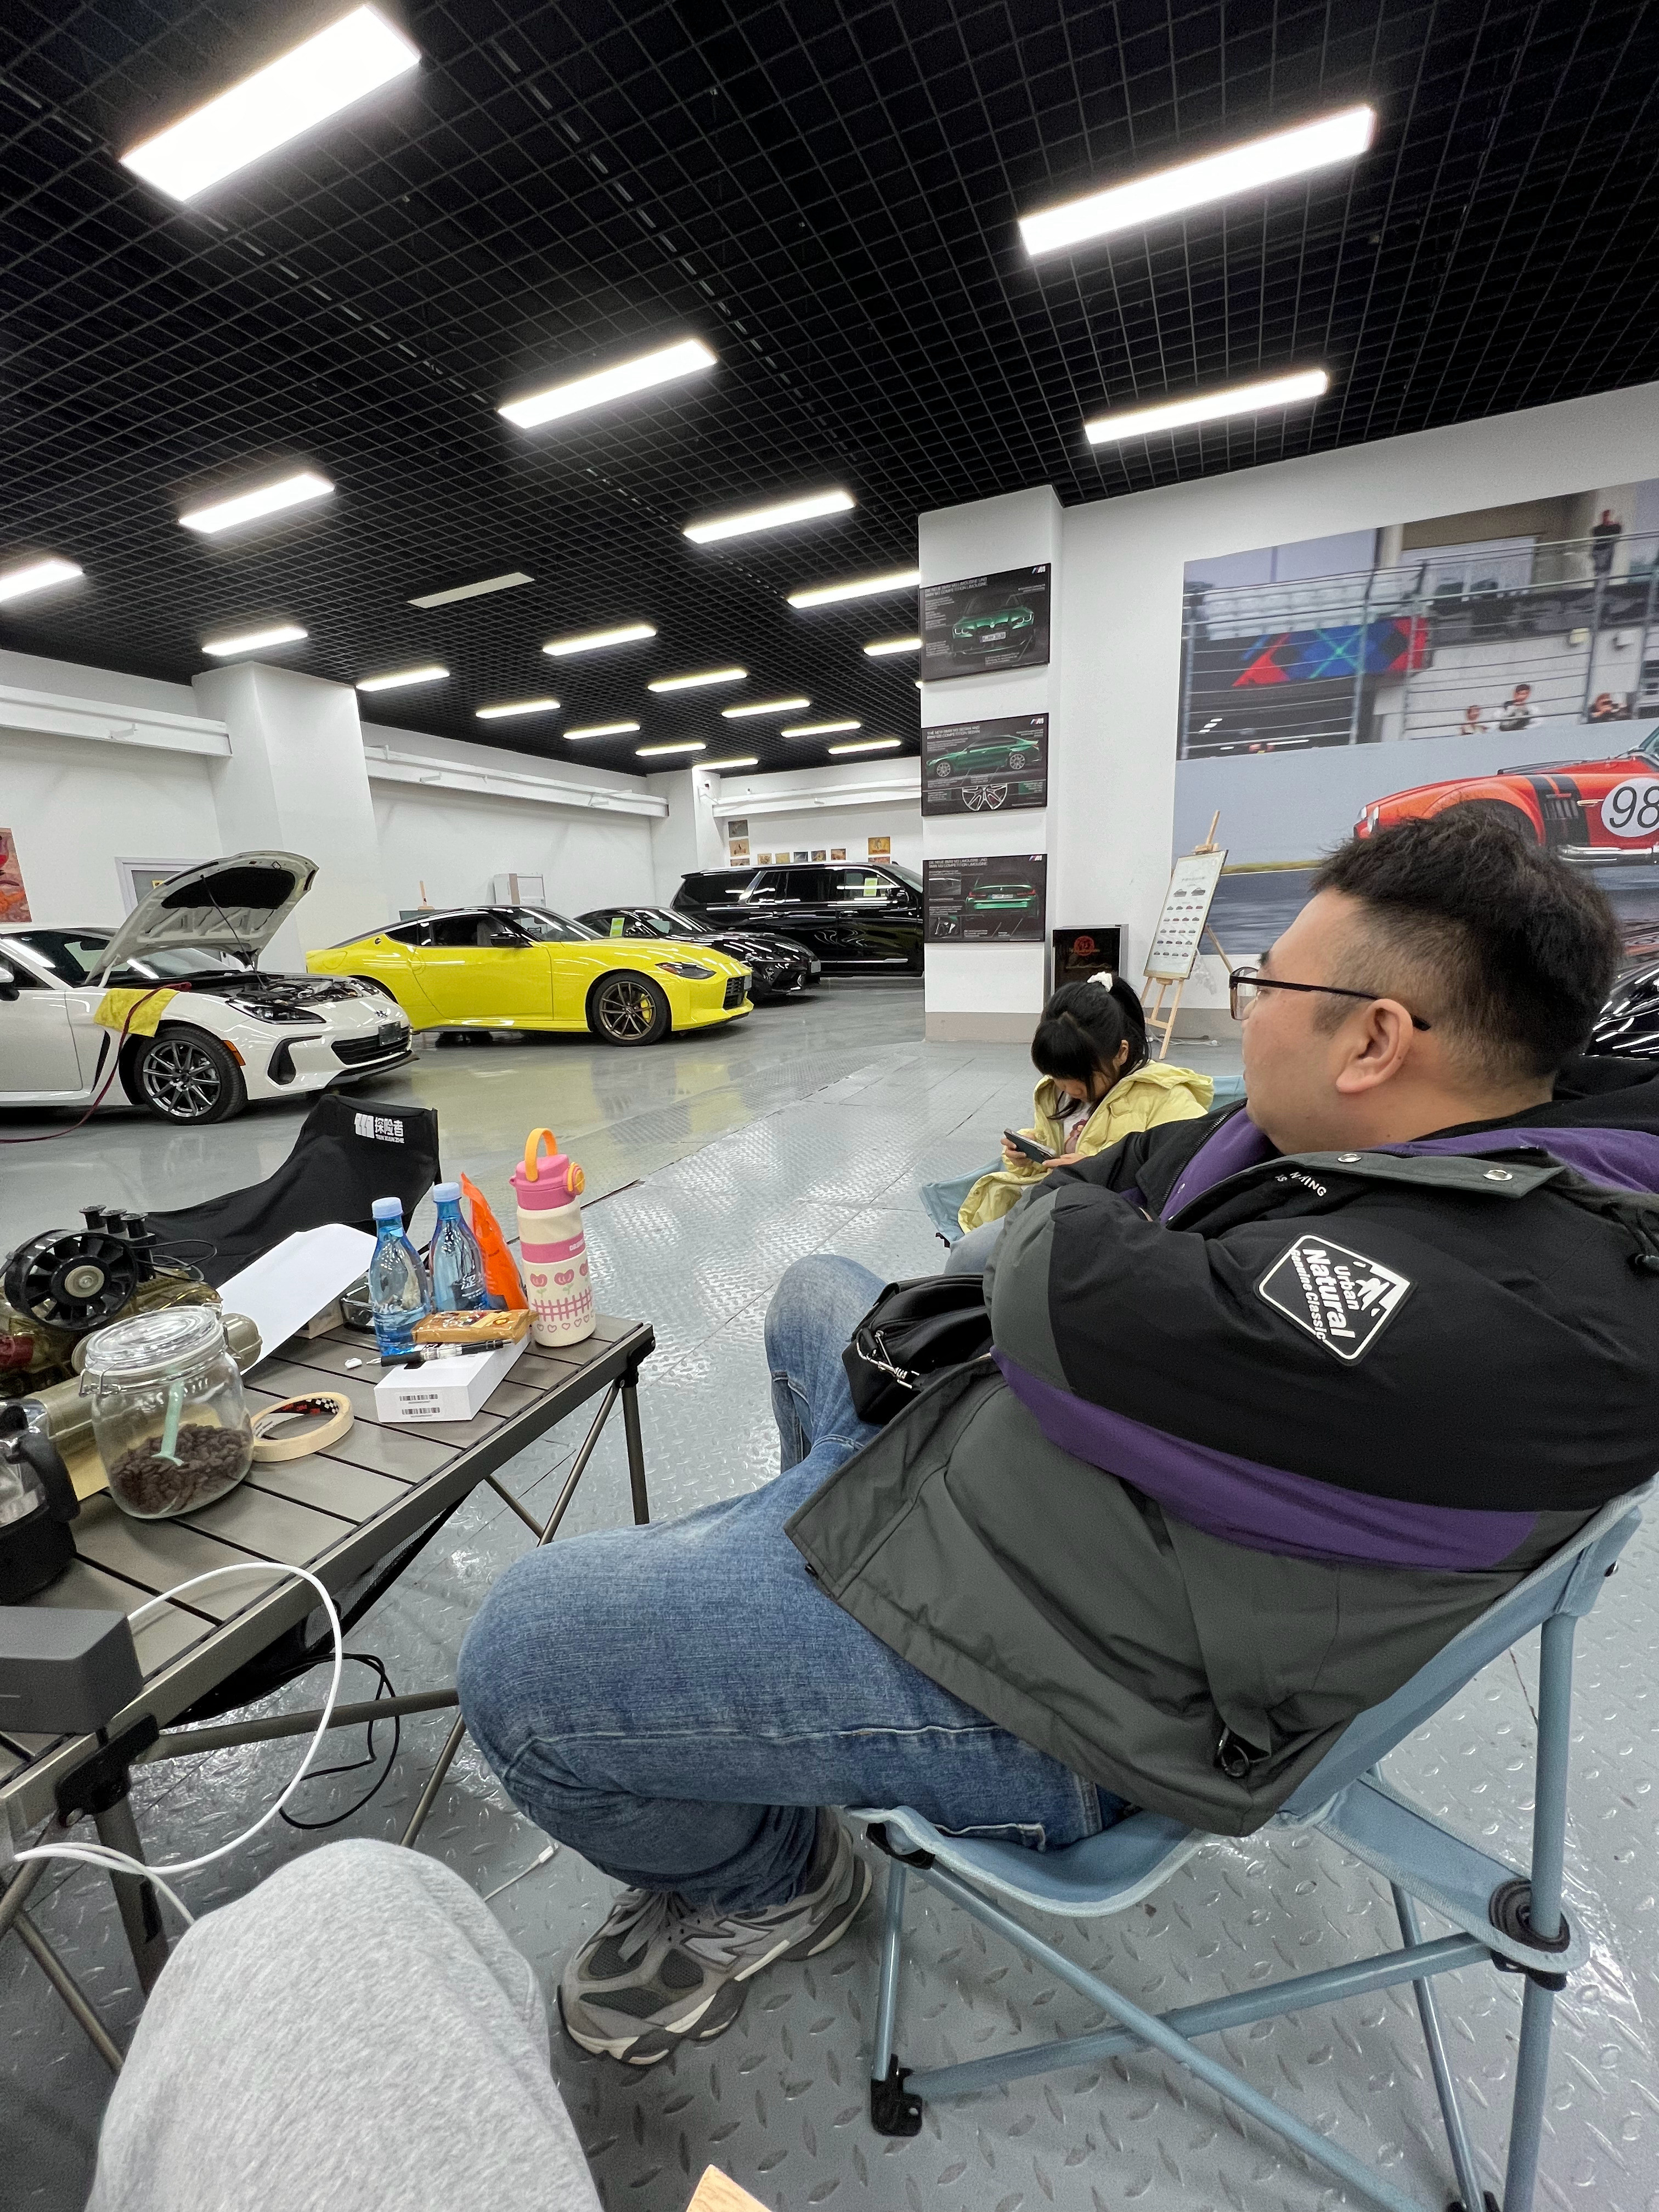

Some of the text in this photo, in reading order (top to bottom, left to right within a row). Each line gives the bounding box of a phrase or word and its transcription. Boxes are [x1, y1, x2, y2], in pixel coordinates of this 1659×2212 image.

[1609, 786, 1659, 828] 98
[1289, 1249, 1313, 1291] Genuine
[1333, 1265, 1360, 1310] Urban
[1302, 1249, 1356, 1338] Natural
[1305, 1291, 1328, 1340] Classic
